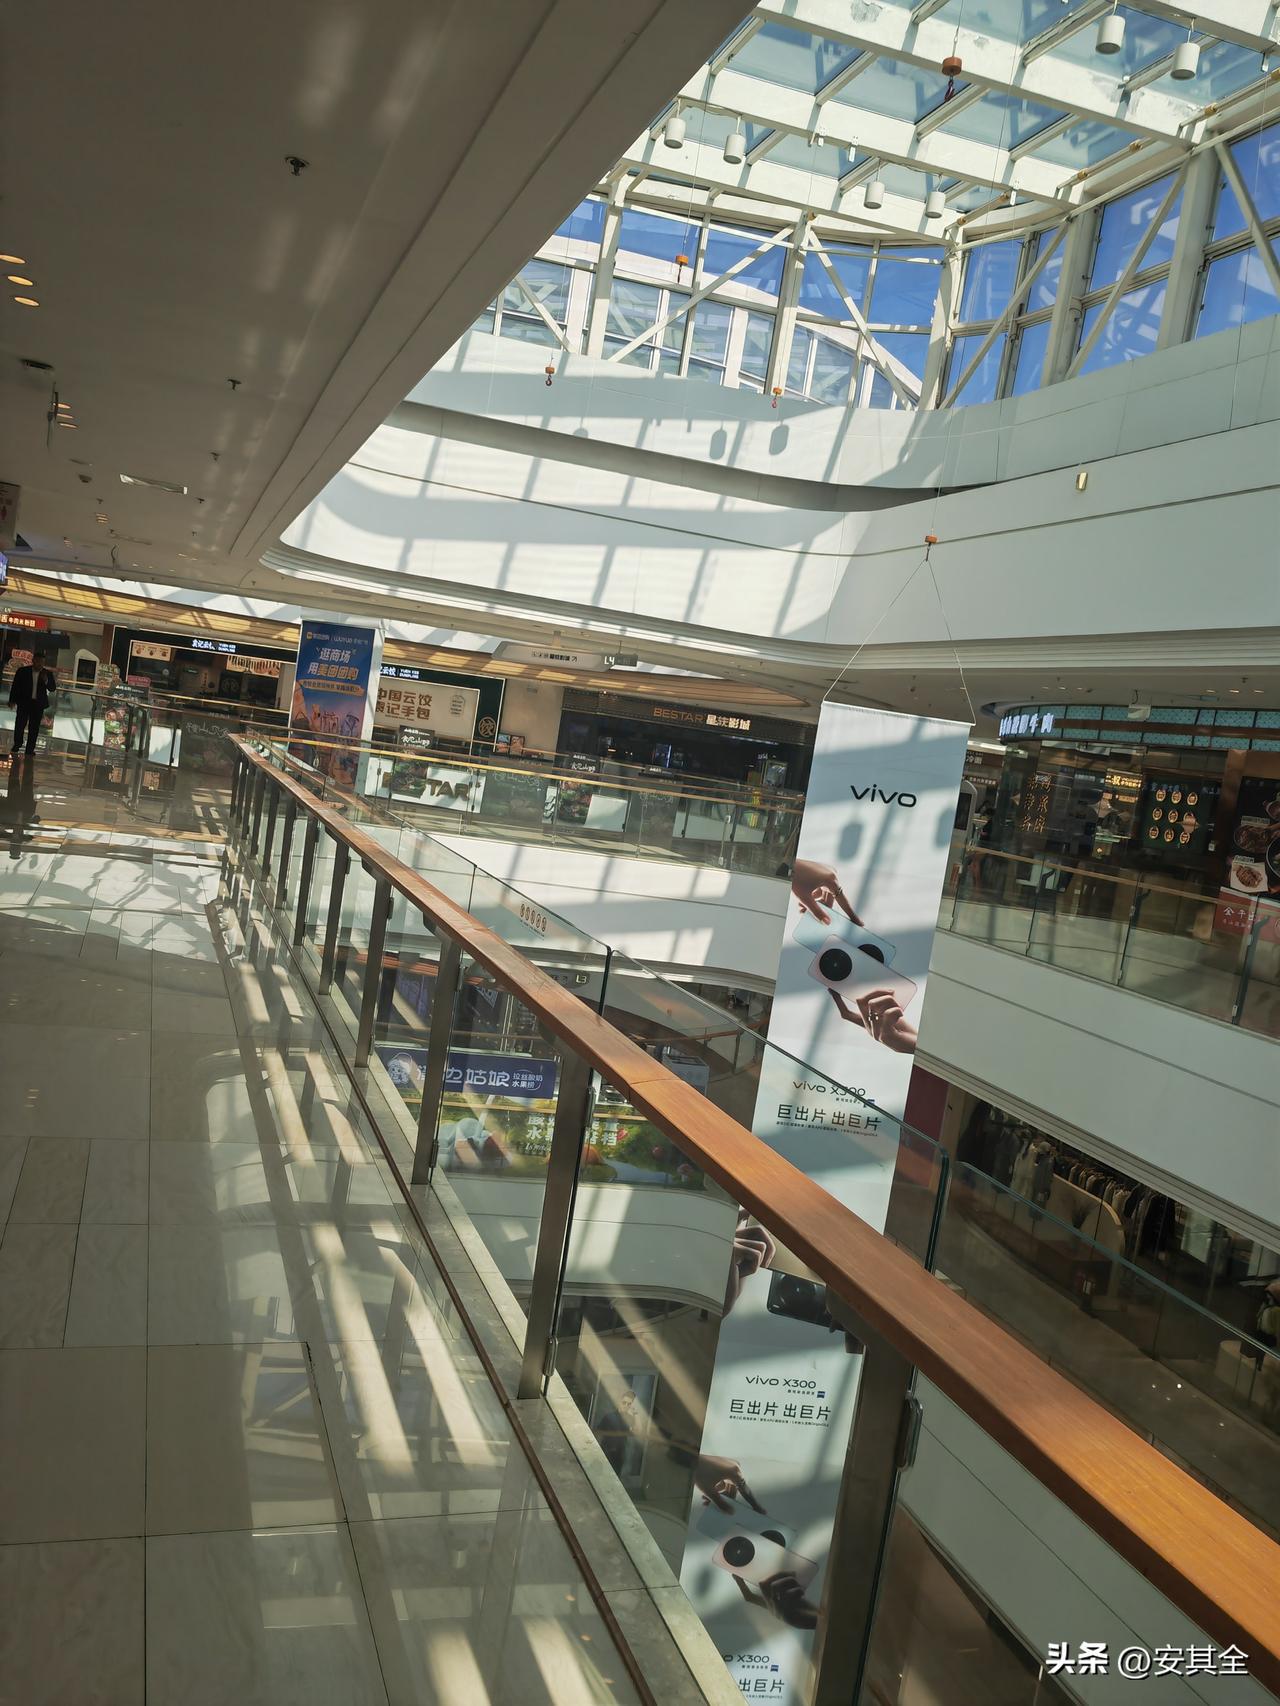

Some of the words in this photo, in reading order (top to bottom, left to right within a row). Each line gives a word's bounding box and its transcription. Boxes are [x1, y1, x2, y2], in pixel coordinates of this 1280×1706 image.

[319, 647, 352, 663] 逛商场
[604, 656, 615, 665] L4
[307, 661, 359, 680] 用美团团购
[653, 707, 704, 724] BESTAR
[850, 783, 917, 808] vivo
[575, 974, 587, 984] L3
[792, 1080, 827, 1093] vivo
[777, 1104, 827, 1124] 巨出片
[831, 1110, 882, 1132] 出巨片
[745, 1375, 779, 1386] vivo
[783, 1378, 817, 1390] X300
[730, 1399, 779, 1417] 巨出片
[783, 1402, 832, 1421] 出巨片
[737, 1654, 770, 1664] X300
[738, 1678, 785, 1694] 出巨片
